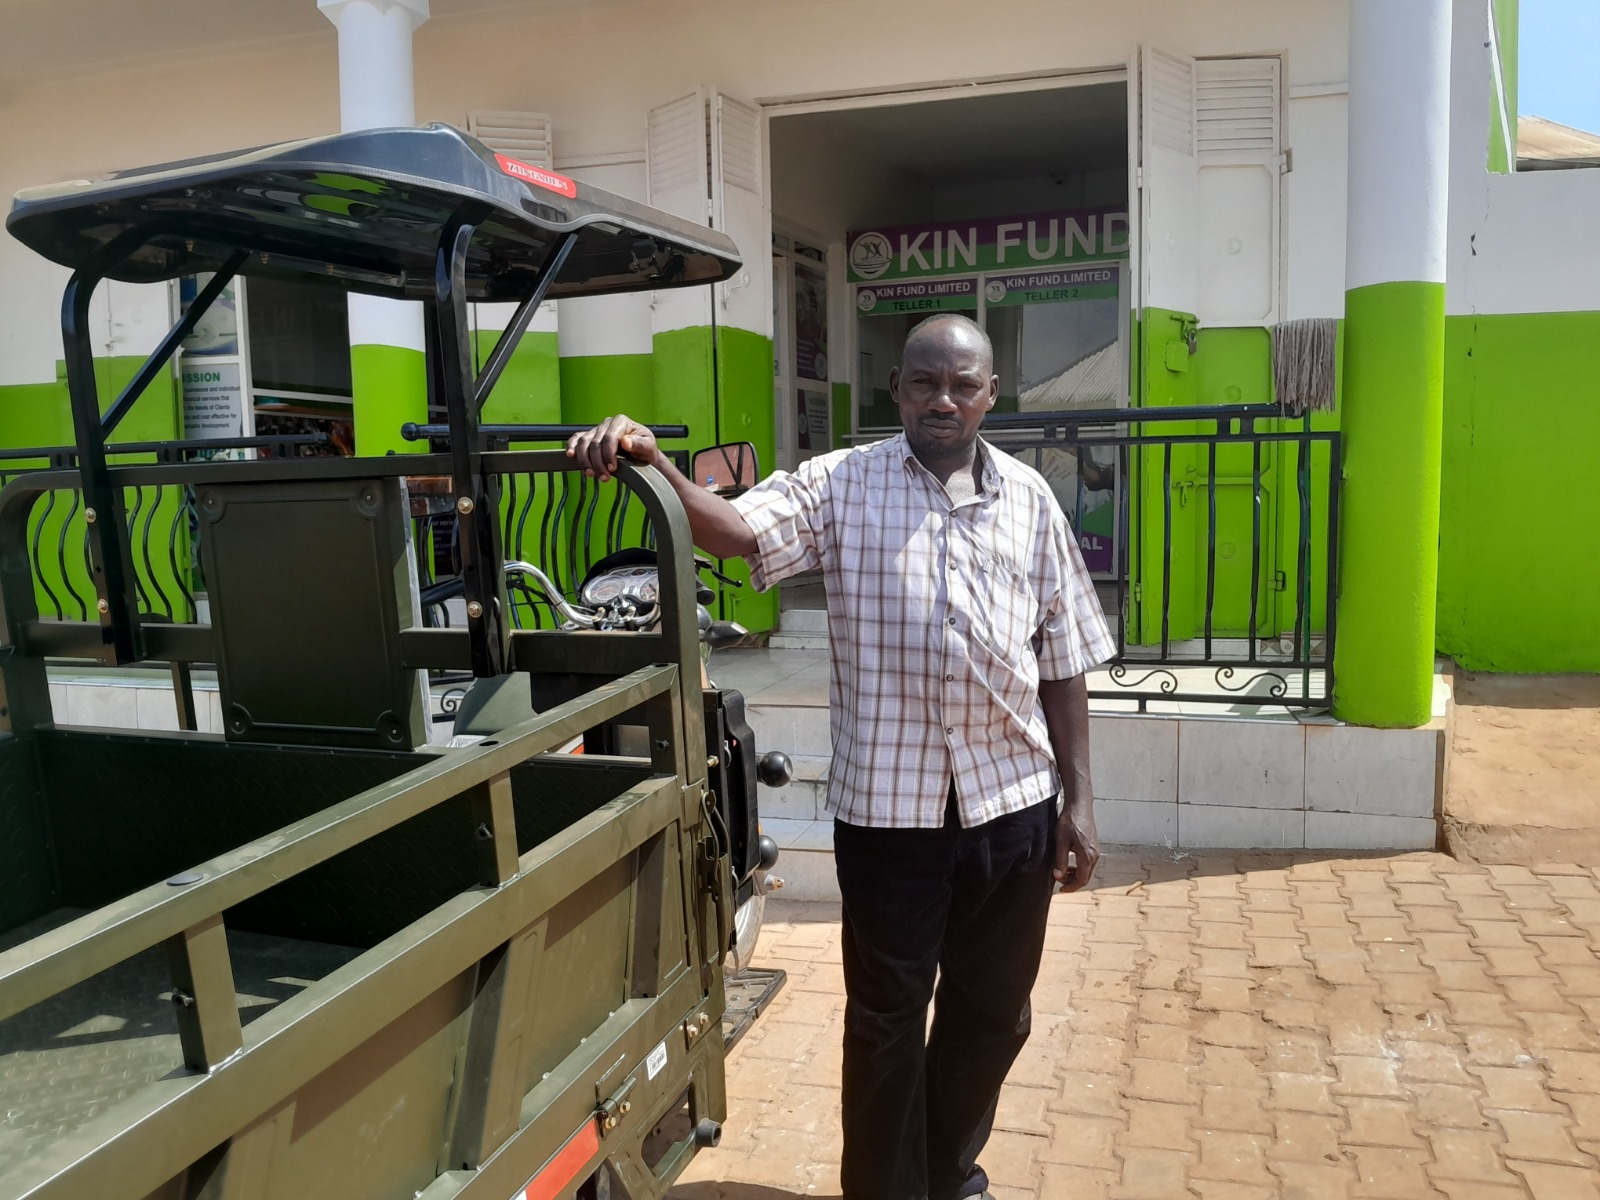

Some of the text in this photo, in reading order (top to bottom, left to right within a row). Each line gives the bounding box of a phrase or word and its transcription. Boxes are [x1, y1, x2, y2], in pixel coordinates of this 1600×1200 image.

[900, 212, 1130, 272] KIN FUND
[1006, 270, 1111, 288] KIN FUND LIMITED
[876, 282, 971, 298] KIN FUND LIMITED
[1024, 289, 1079, 301] TELLER 2
[893, 300, 941, 311] TELLER 1
[182, 372, 221, 383] ISSION
[1081, 536, 1103, 550] AL
